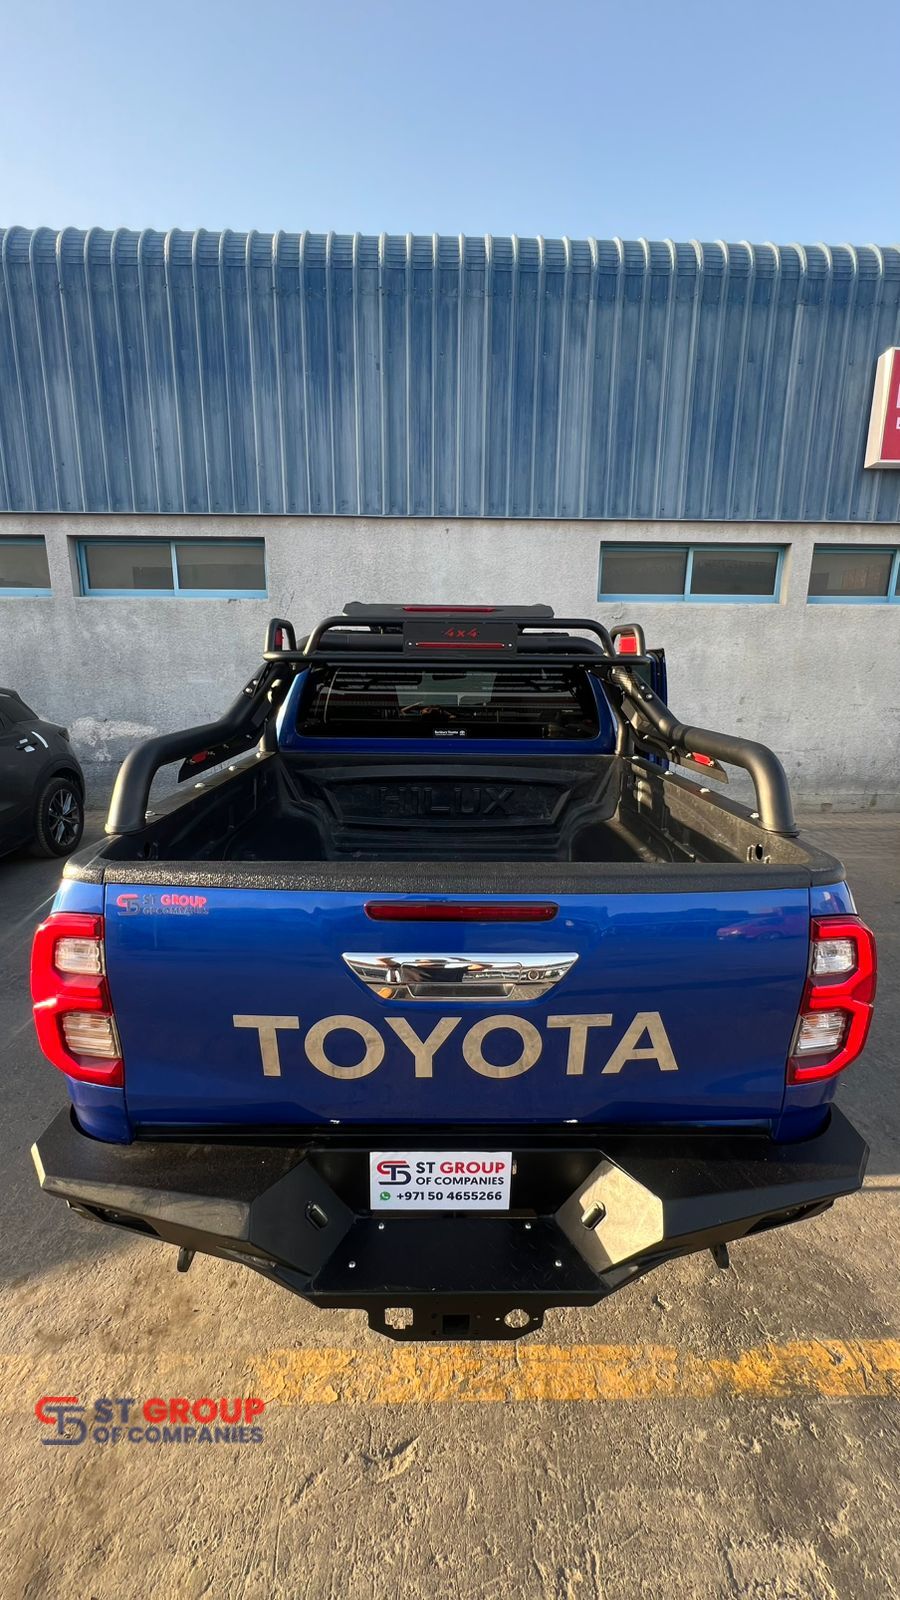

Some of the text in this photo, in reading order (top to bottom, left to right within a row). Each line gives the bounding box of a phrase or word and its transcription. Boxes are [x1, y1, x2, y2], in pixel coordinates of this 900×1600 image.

[378, 786, 514, 815] HILUX
[160, 894, 207, 907] GROUP
[233, 1012, 678, 1079] TOYOTA
[416, 1162, 505, 1173] ST GROUP
[416, 1177, 504, 1185] OF COMPANIES
[397, 1192, 502, 1200] +971 50 4655266
